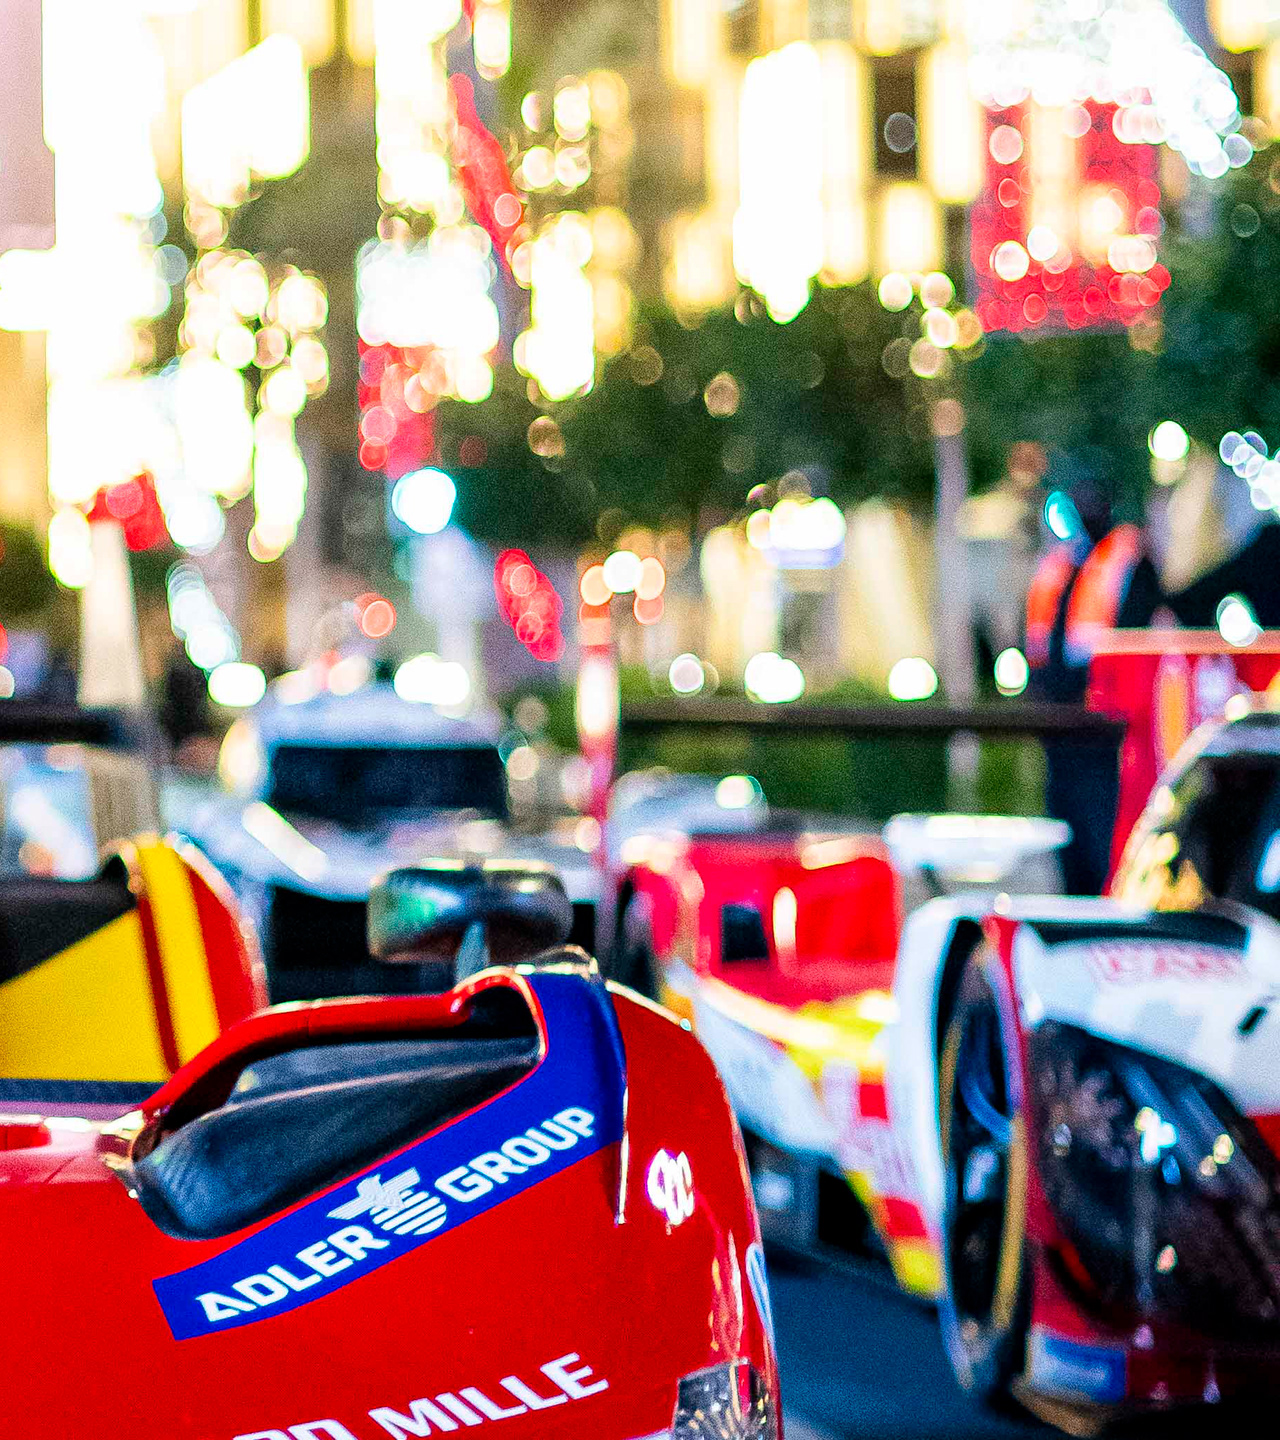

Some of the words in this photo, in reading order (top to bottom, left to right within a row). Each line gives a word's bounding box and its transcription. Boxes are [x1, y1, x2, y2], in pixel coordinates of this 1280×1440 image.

[195, 1224, 390, 1323] ADLER
[433, 1106, 596, 1203] GROUP
[367, 1351, 609, 1440] MILLE
